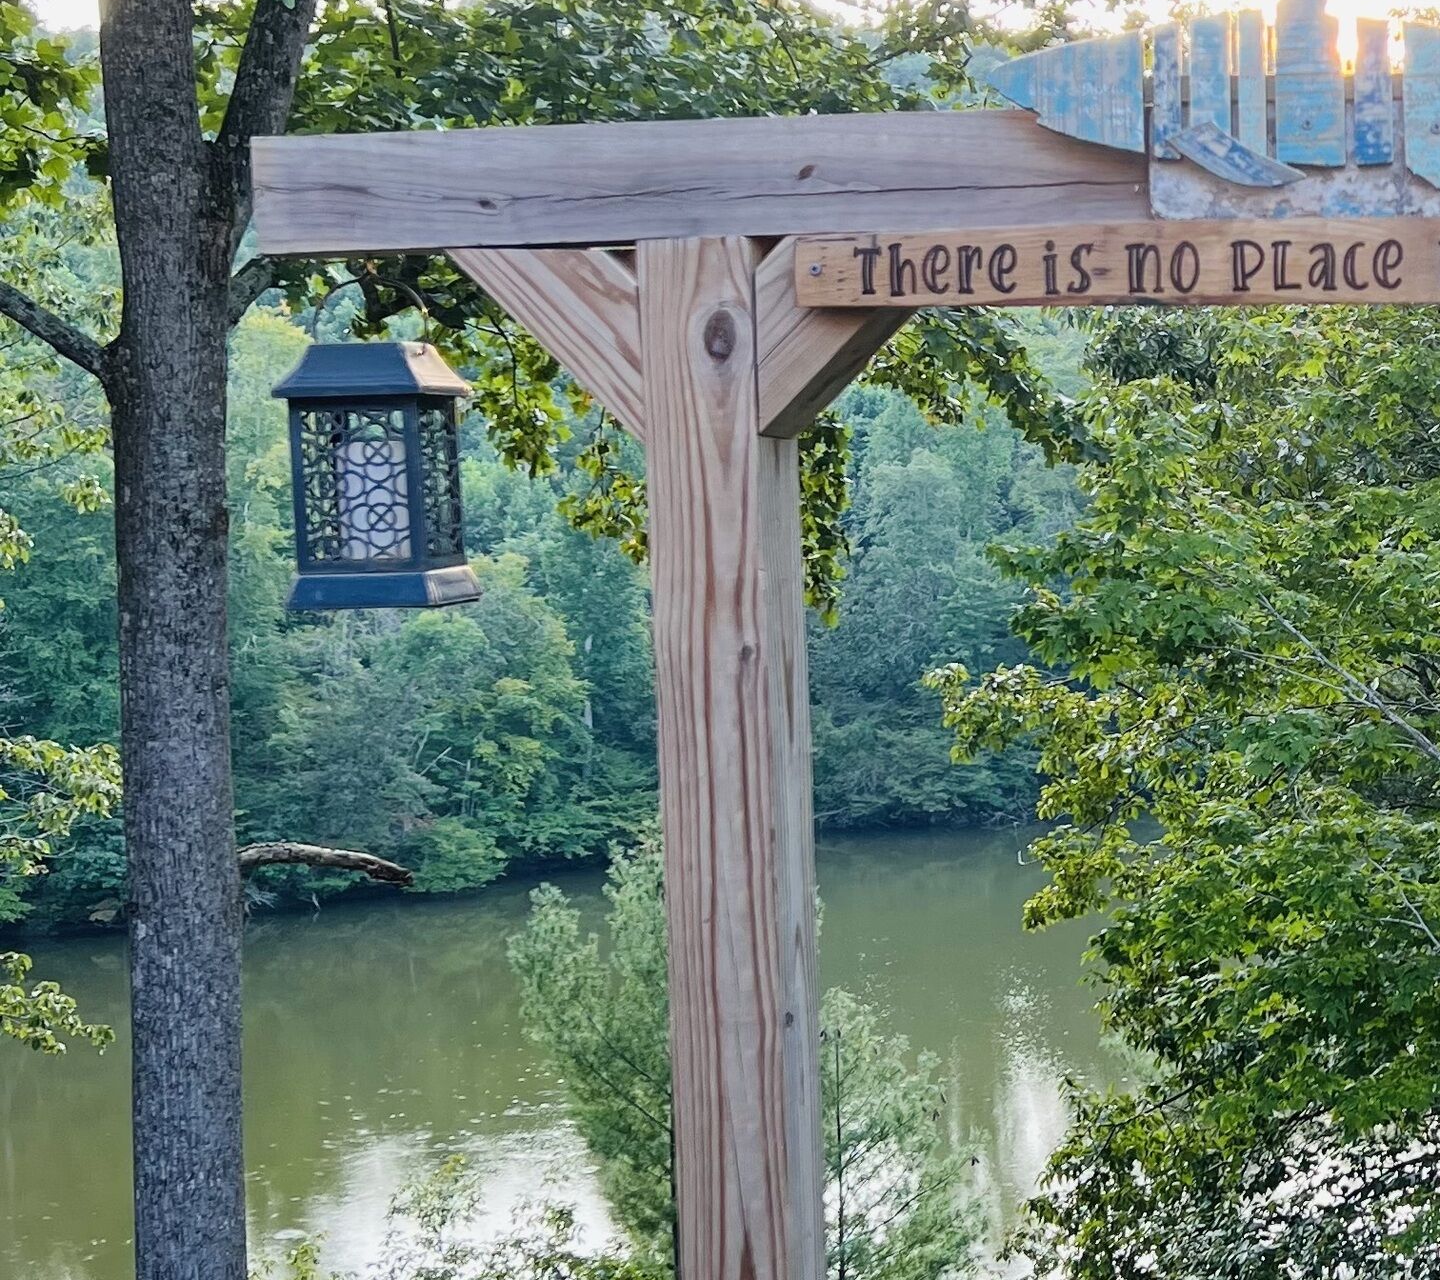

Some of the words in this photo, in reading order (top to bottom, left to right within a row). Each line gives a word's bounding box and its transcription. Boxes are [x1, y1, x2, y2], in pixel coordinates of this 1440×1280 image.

[853, 240, 1019, 297] There
[1042, 238, 1094, 296] is
[1124, 240, 1201, 295] no
